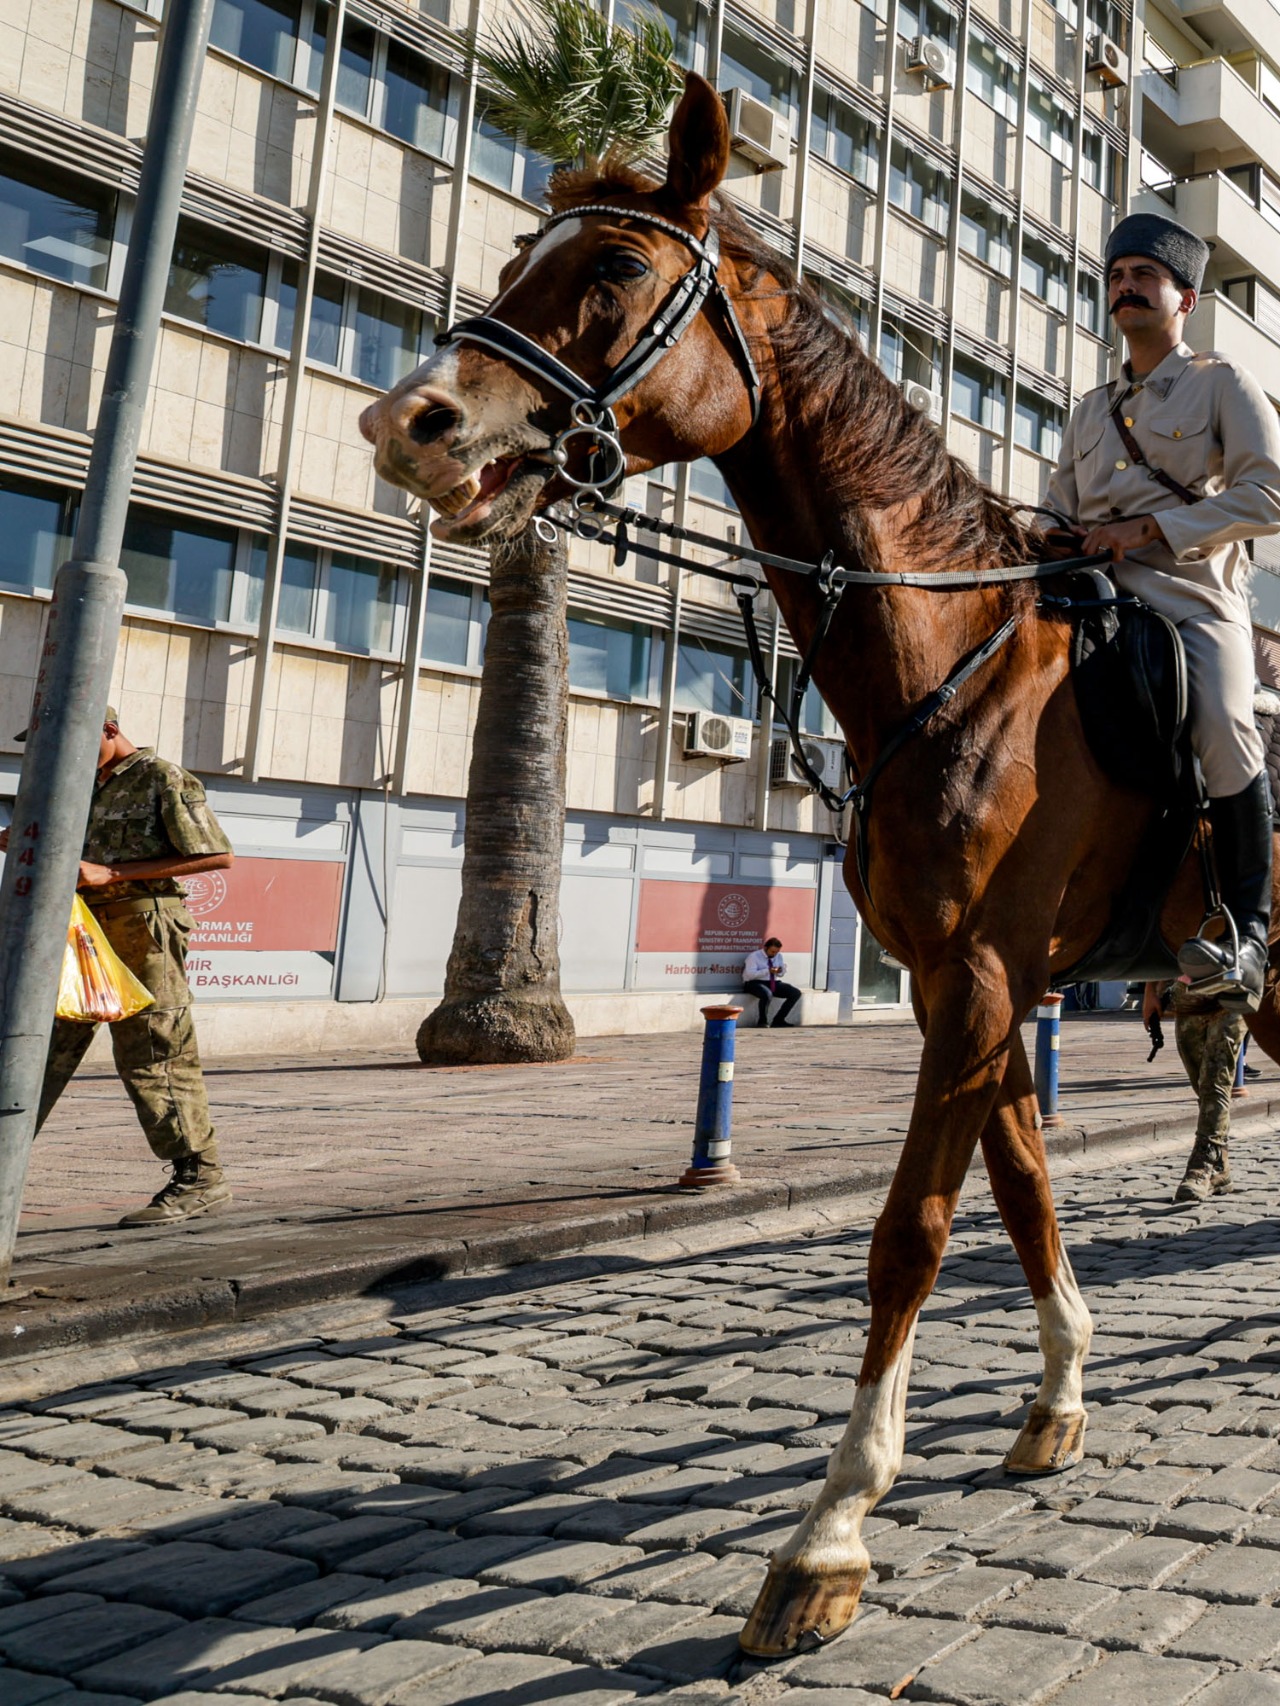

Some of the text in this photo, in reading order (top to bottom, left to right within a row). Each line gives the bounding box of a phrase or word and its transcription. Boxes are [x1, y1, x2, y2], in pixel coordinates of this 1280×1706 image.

[236, 922, 254, 931] VE
[189, 932, 252, 943] AKANLIĞI
[665, 964, 707, 974] Harbour
[196, 972, 299, 988] BAŞKANLIĞI
